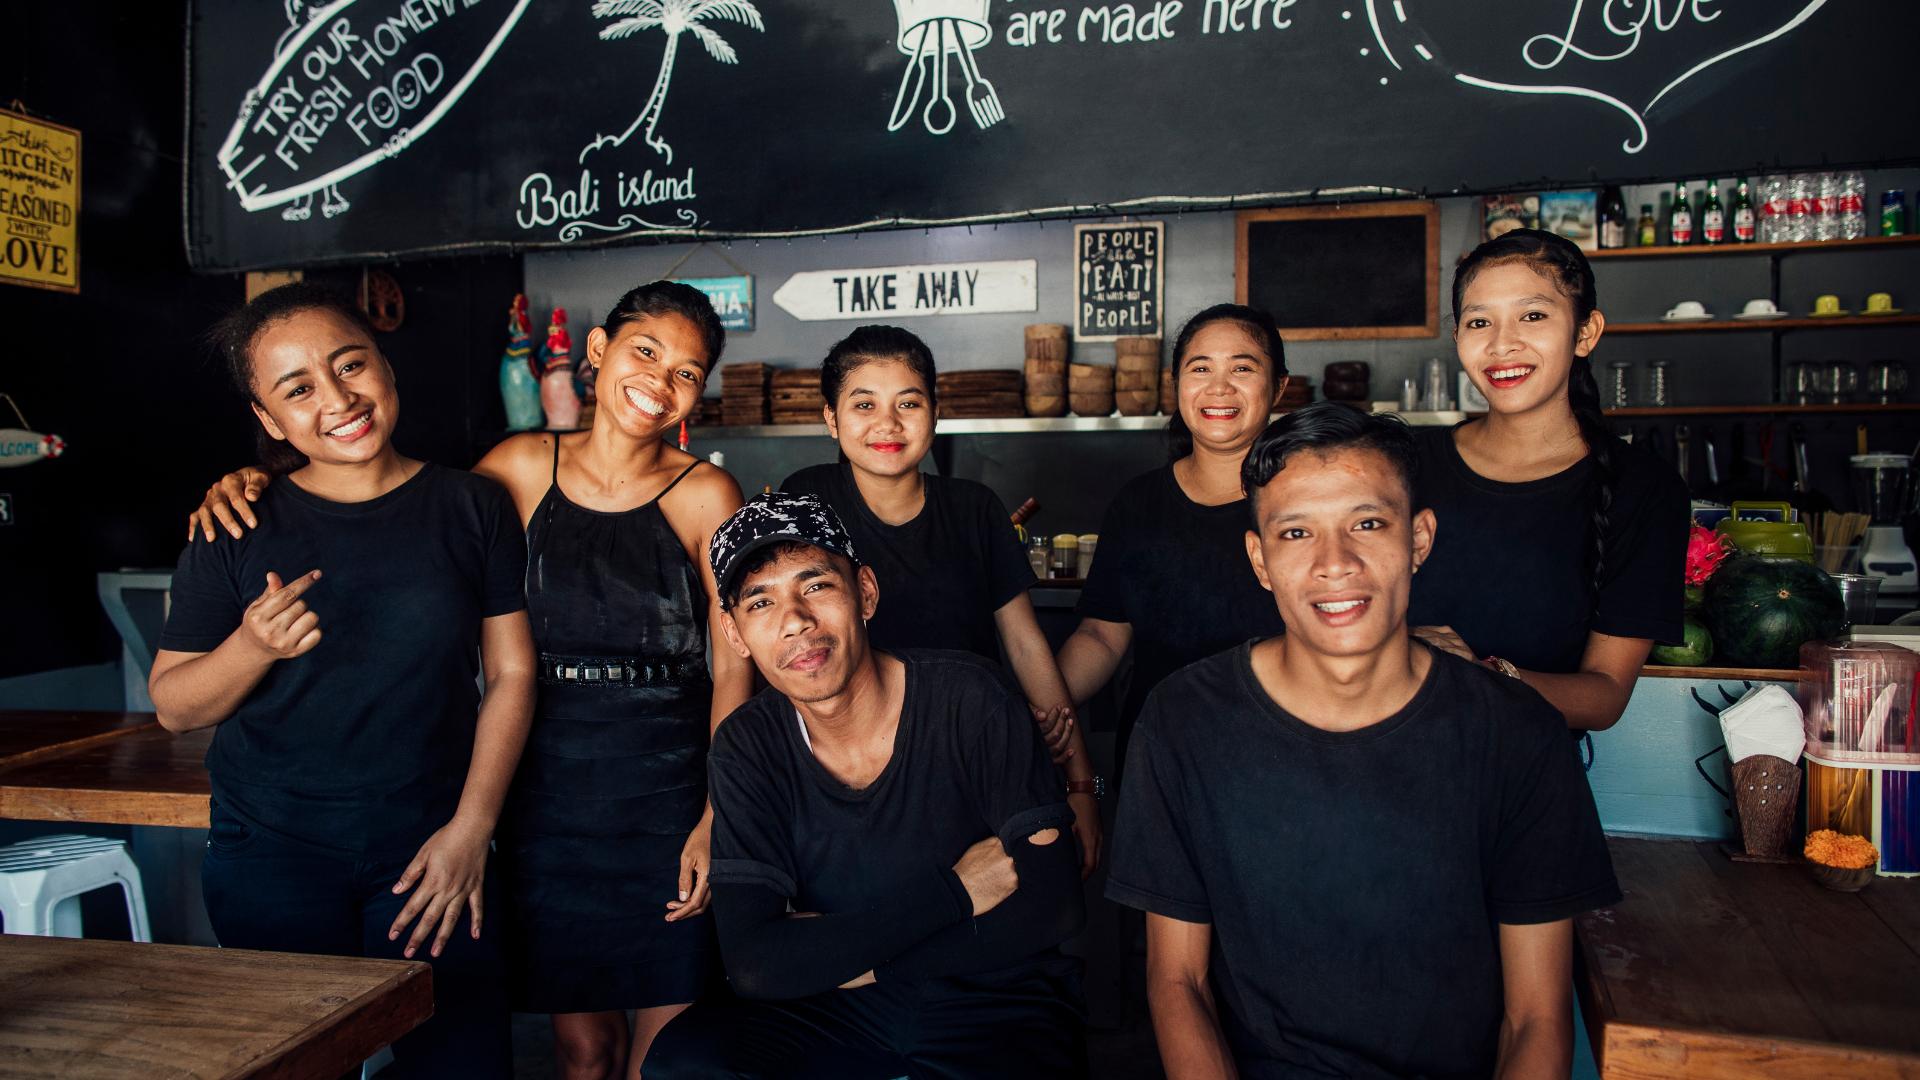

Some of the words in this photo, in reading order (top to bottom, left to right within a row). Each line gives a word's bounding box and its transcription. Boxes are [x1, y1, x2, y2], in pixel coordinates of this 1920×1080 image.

[1005, 9, 1066, 47] are
[252, 75, 305, 137] TRY
[302, 17, 360, 81] OUR
[274, 74, 353, 172] FRESH
[347, 0, 481, 81] HOMEM
[345, 52, 444, 146] FOOD
[0, 147, 73, 185] ITCHEN
[0, 188, 72, 228] EASONED
[516, 169, 600, 230] Bali
[617, 167, 697, 208] island
[0, 237, 69, 277] OVE
[1084, 230, 1155, 258] PEOPLE
[833, 274, 897, 313] TAKE
[915, 268, 979, 309] AWAY
[1094, 262, 1144, 293] EAT
[1083, 300, 1153, 328] PEOPLE
